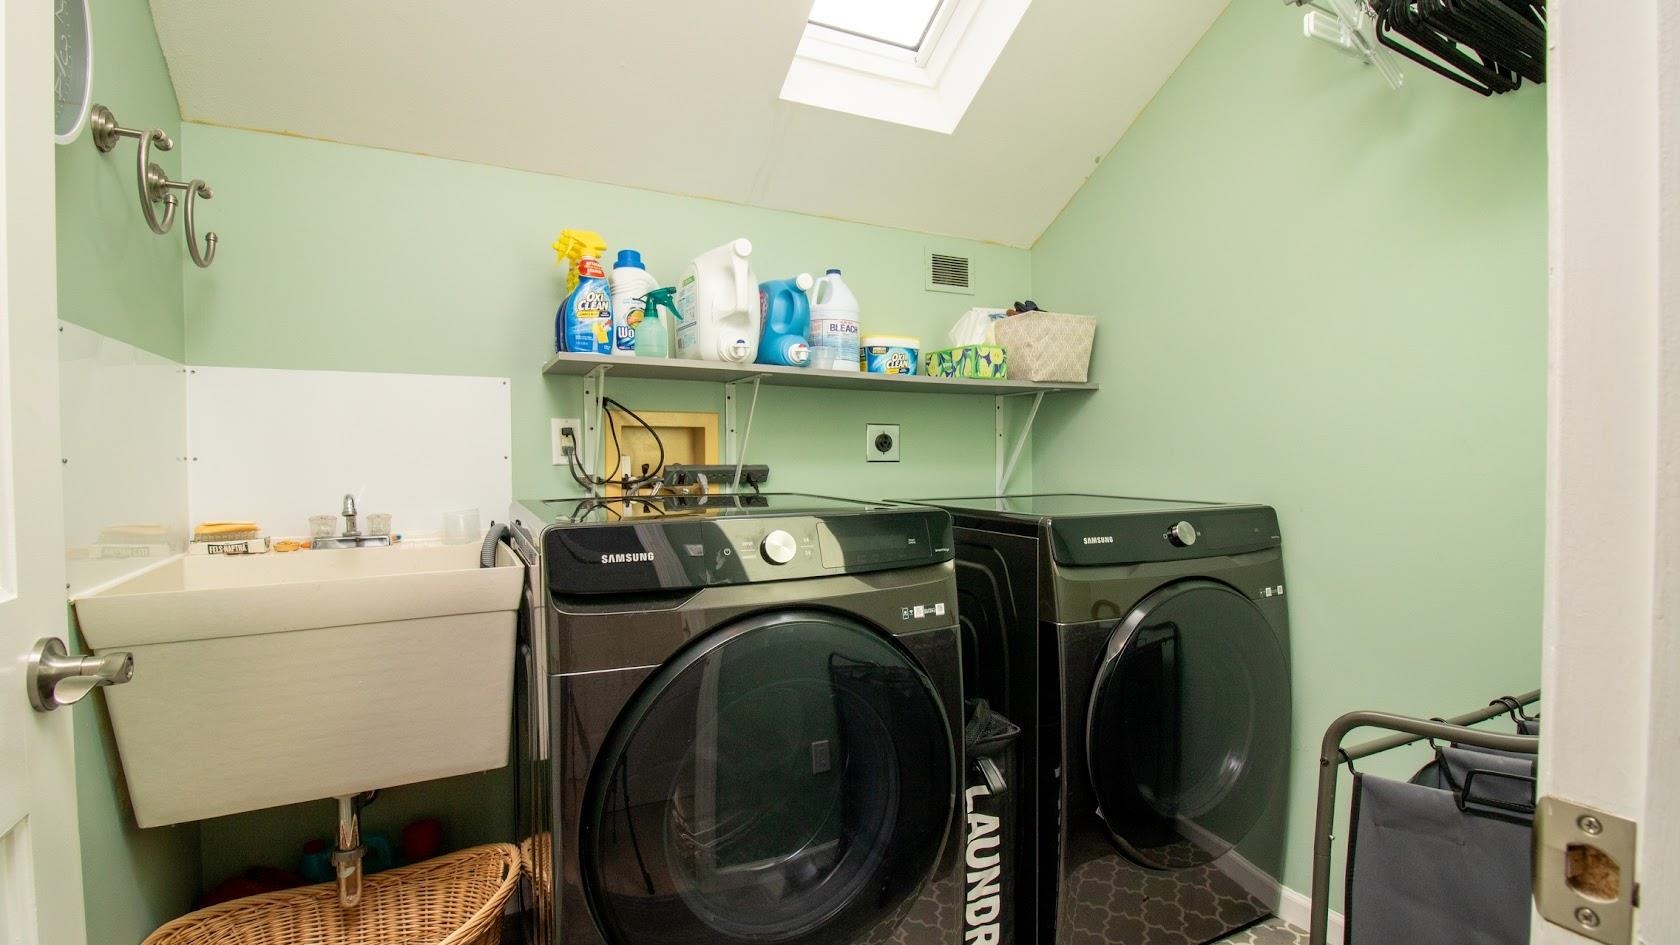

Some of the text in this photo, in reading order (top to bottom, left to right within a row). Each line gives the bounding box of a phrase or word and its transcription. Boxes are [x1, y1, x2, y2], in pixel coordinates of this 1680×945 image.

[587, 291, 604, 301] OXI
[578, 300, 609, 310] CLEAN
[1083, 535, 1114, 545] SAMSUNG
[601, 551, 655, 564] SAMSUNG
